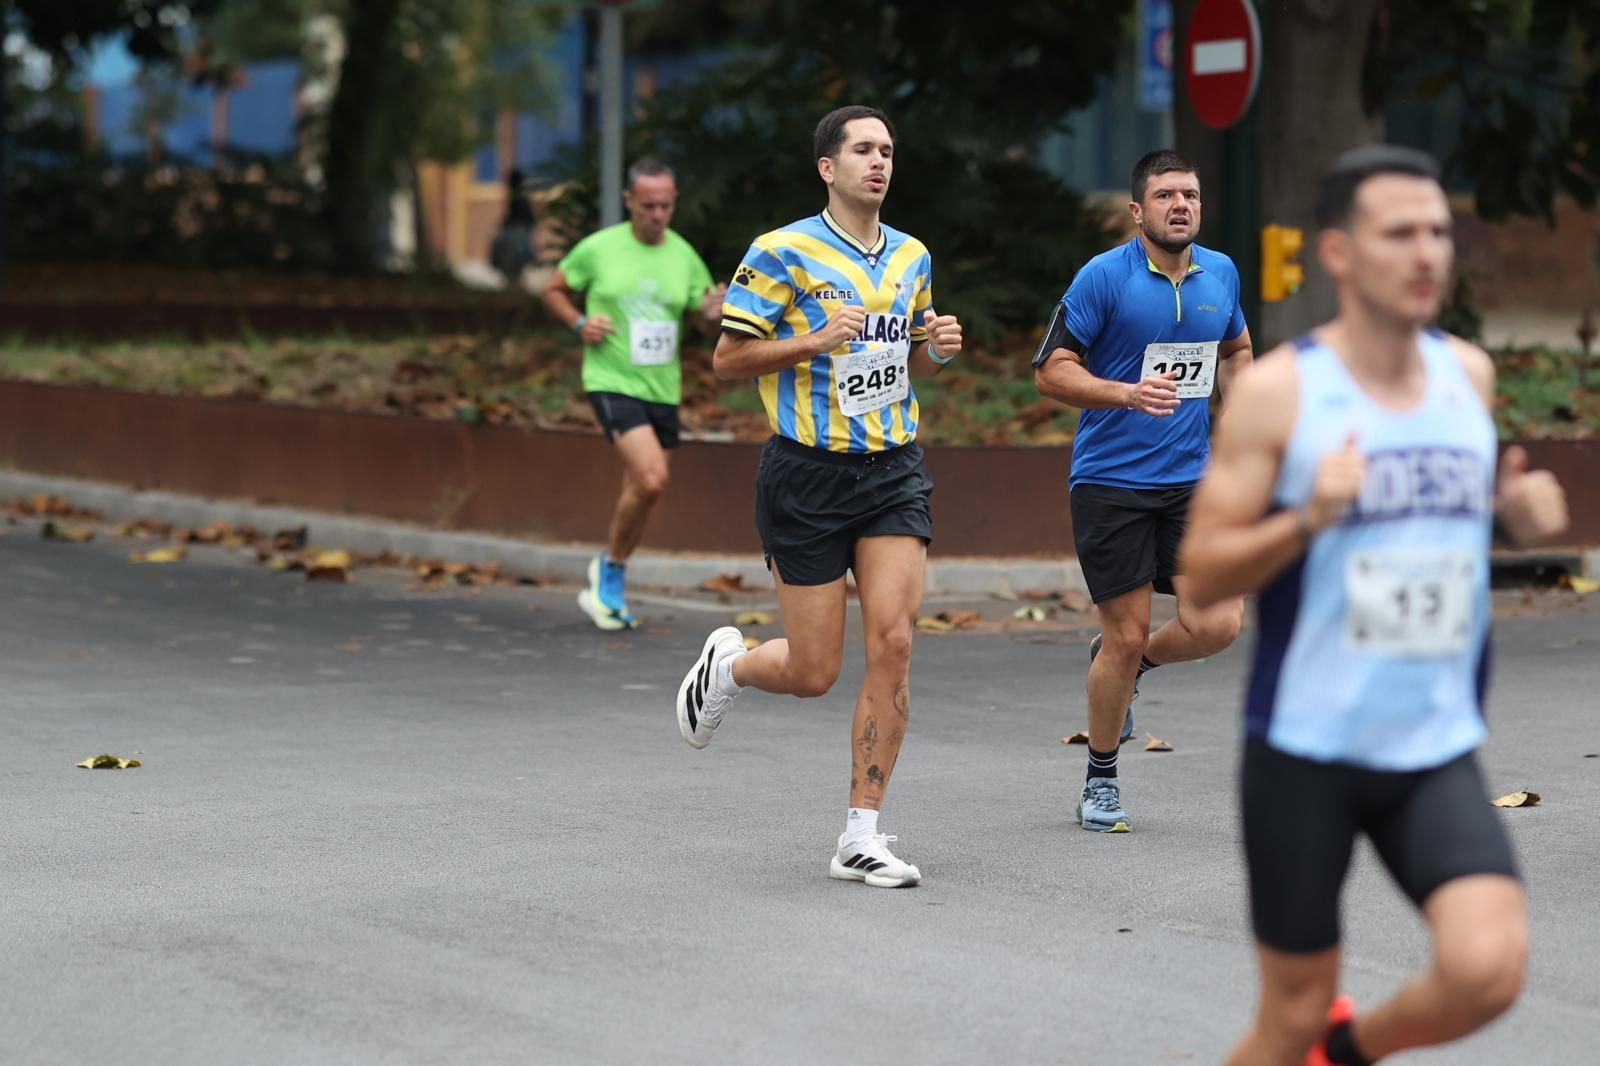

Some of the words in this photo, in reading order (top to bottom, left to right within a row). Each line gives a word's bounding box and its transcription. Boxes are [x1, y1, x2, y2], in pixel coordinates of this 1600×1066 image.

[815, 290, 853, 300] KELME
[846, 314, 908, 343] LAGA
[847, 365, 897, 397] 248
[1153, 361, 1203, 381] 107
